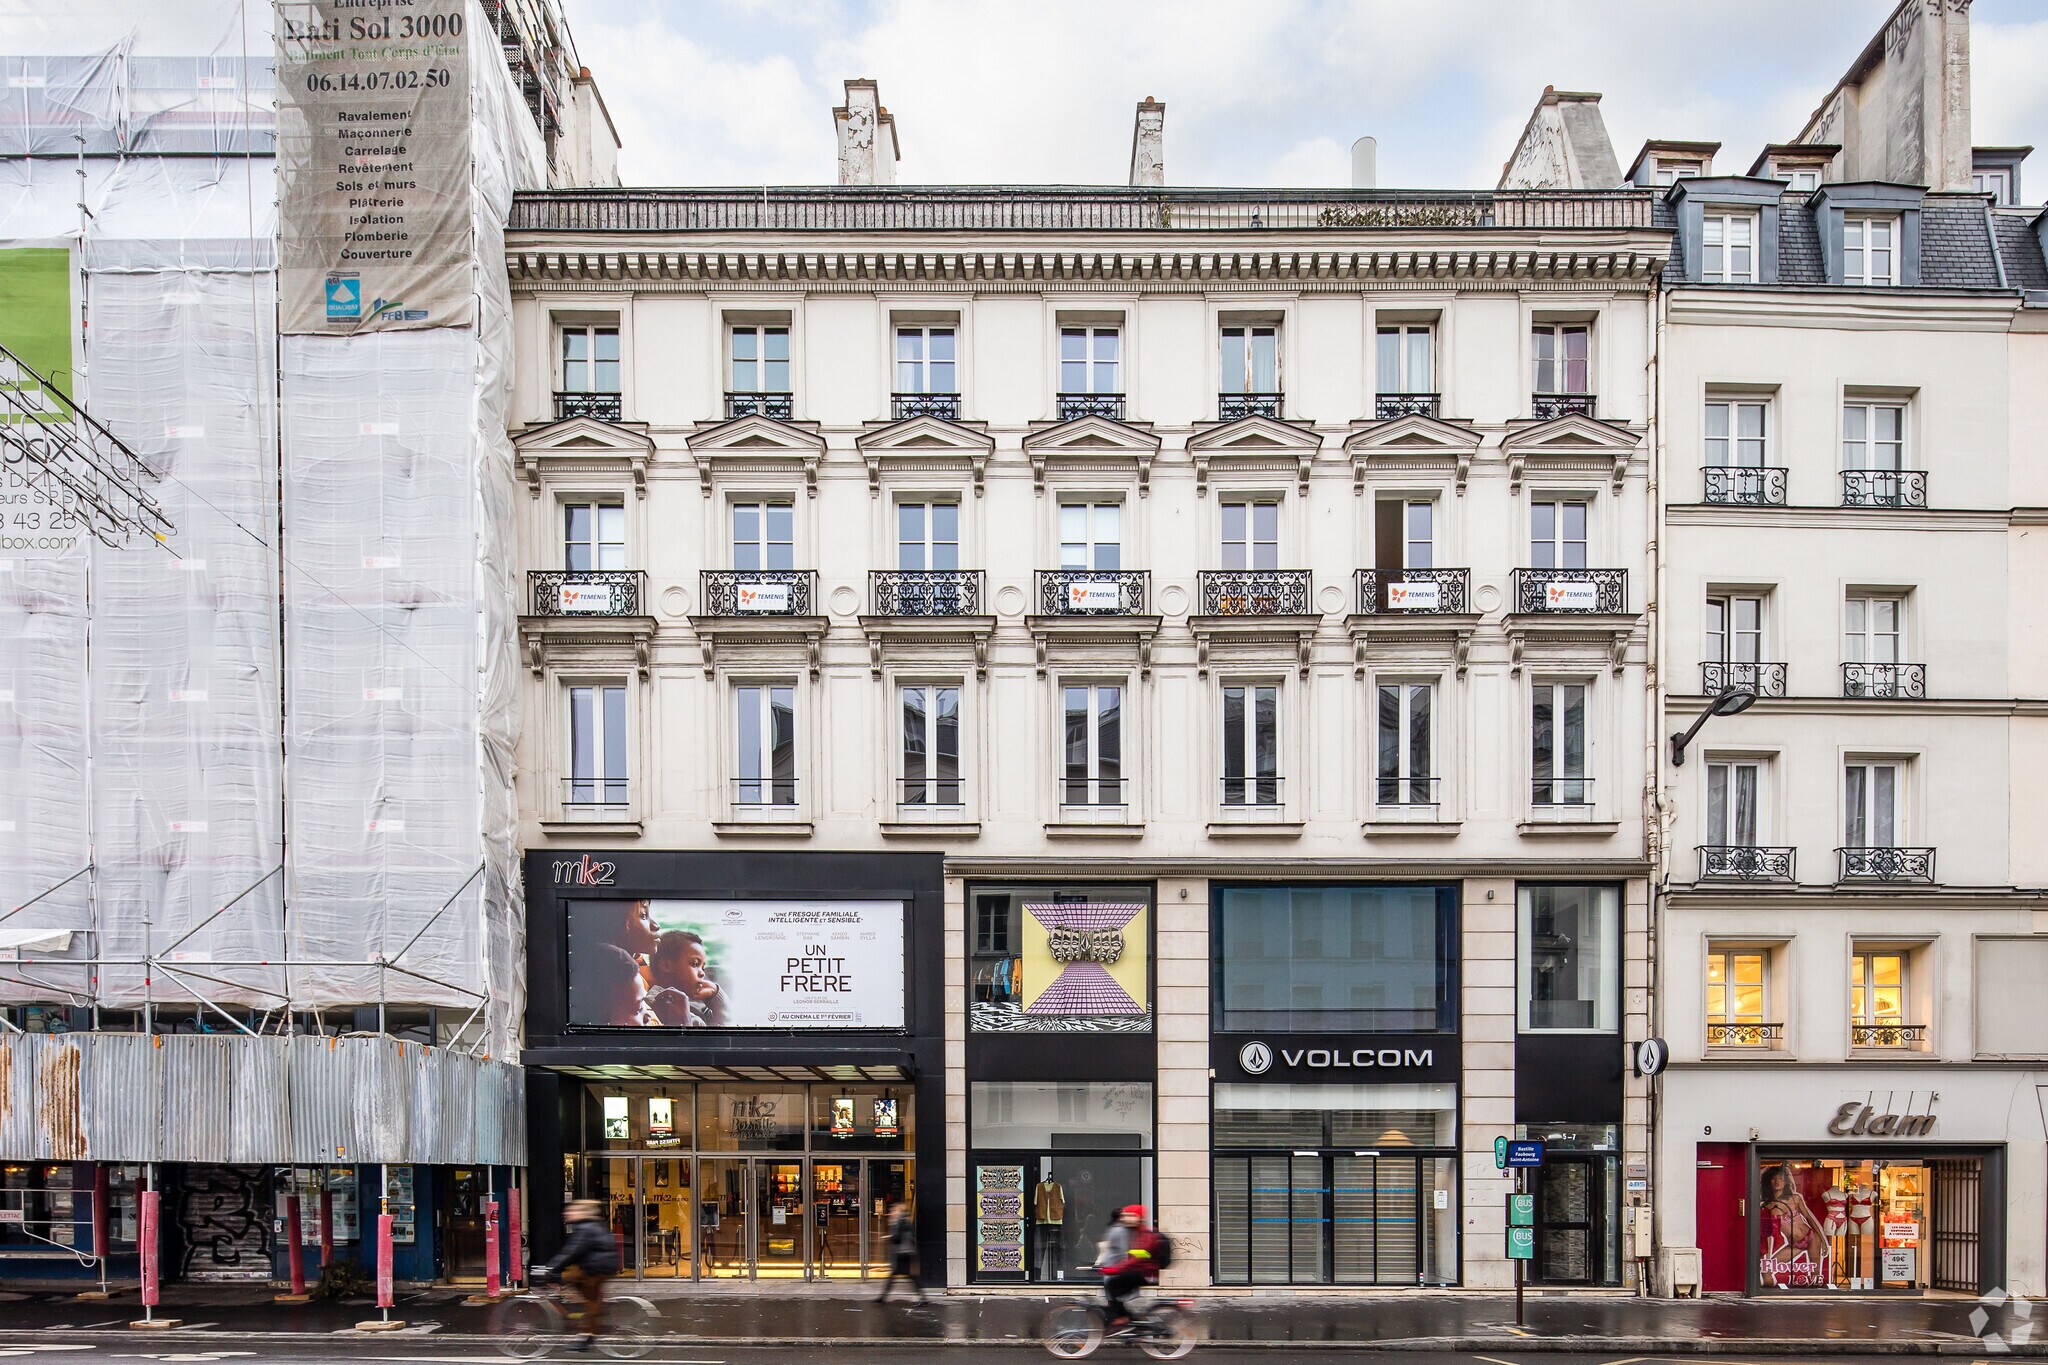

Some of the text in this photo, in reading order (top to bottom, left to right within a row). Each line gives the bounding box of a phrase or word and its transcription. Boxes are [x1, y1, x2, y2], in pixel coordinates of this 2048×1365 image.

[350, 16, 391, 40] Sol
[399, 13, 464, 39] 3000
[306, 68, 451, 92] 06.14.07.02.50
[338, 110, 412, 122] Ravalement
[338, 127, 413, 141] Maçonnerie
[345, 145, 407, 158] Carrelage
[338, 162, 414, 174] Revêtement
[336, 179, 417, 191] Sols et murs
[349, 198, 404, 209] Plâtrerie
[350, 214, 404, 225] Isolation
[344, 231, 409, 242] Plomberie
[340, 247, 413, 260] Couverture
[552, 854, 616, 886] mk2
[805, 945, 826, 956] UN
[787, 958, 846, 974] PETIT
[781, 974, 852, 992] FRÈRE
[1281, 1049, 1433, 1067] VOLCOM
[731, 1096, 776, 1117] mk2
[1828, 1101, 1937, 1136] Etam
[1703, 1125, 1712, 1136] 9
[1517, 1199, 1533, 1207] BUS
[1760, 1258, 1817, 1273] Flower
